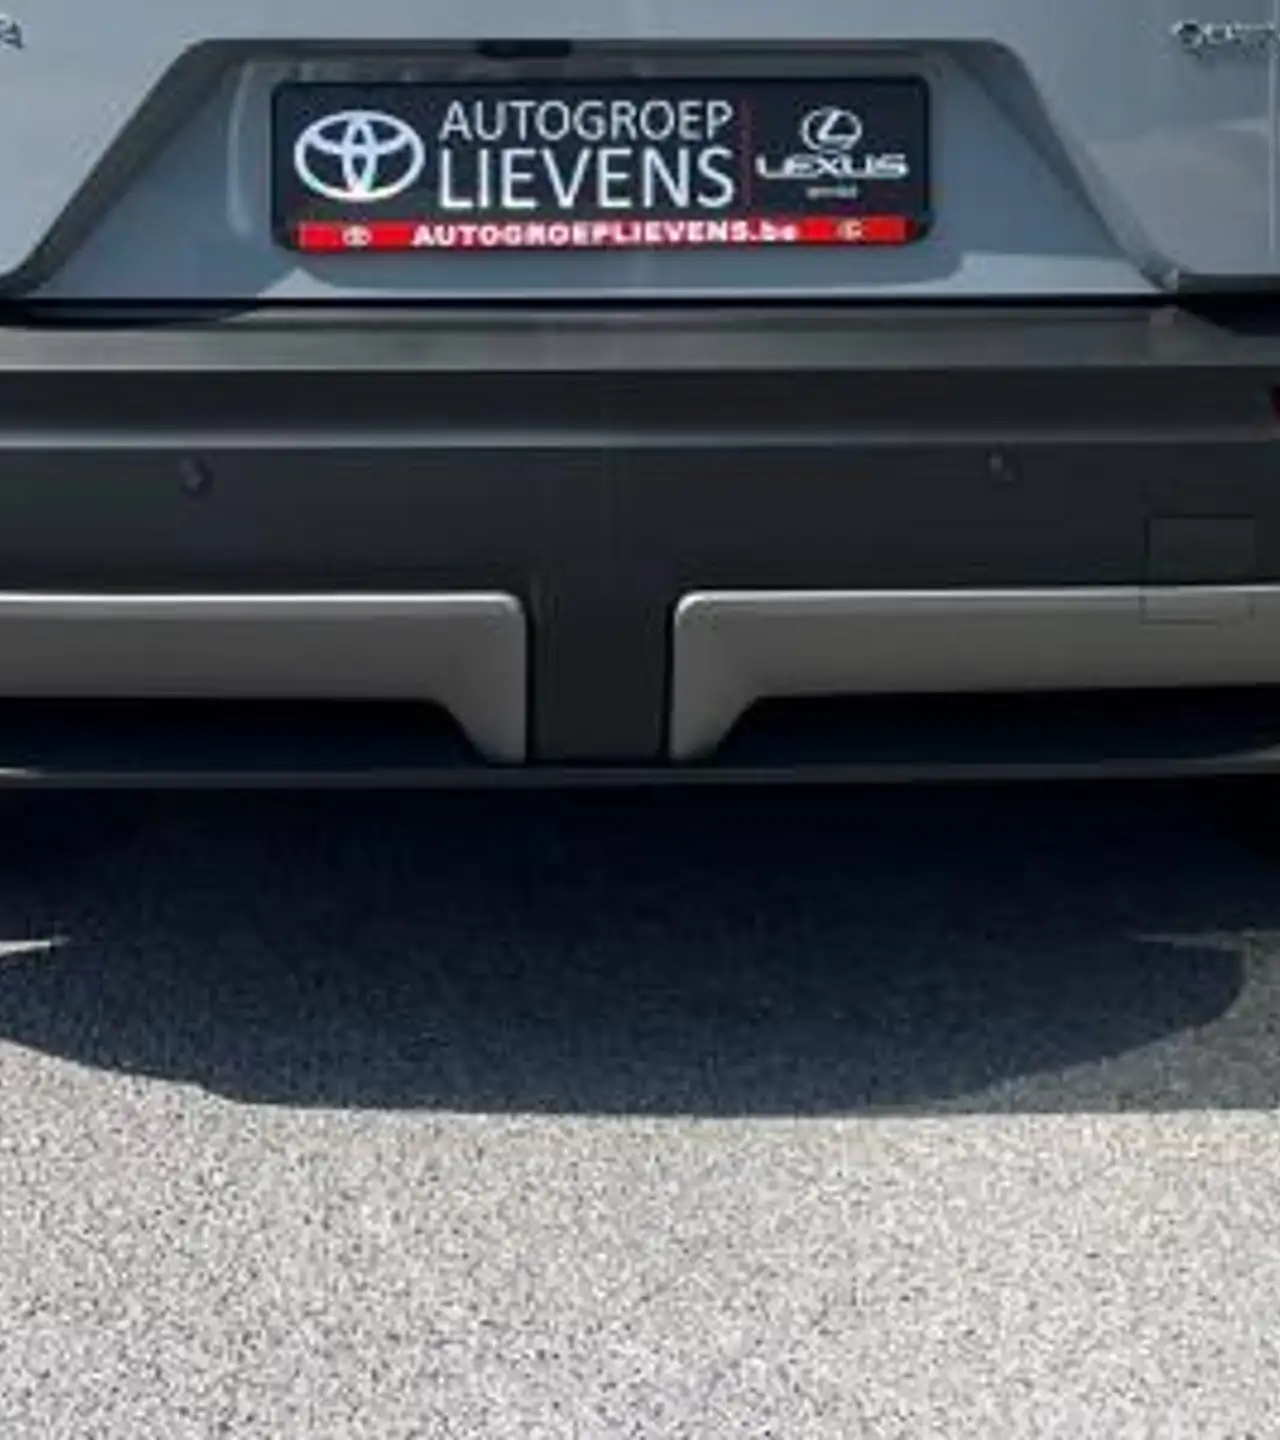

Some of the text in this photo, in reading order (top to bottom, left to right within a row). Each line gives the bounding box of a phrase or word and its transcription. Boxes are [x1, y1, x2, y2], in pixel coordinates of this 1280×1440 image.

[438, 99, 734, 141] AUTOGROEP
[439, 146, 735, 209] LIEVENS
[754, 153, 910, 179] LEXUS
[411, 219, 800, 247] AUTOGROEPLIEVENS.be
